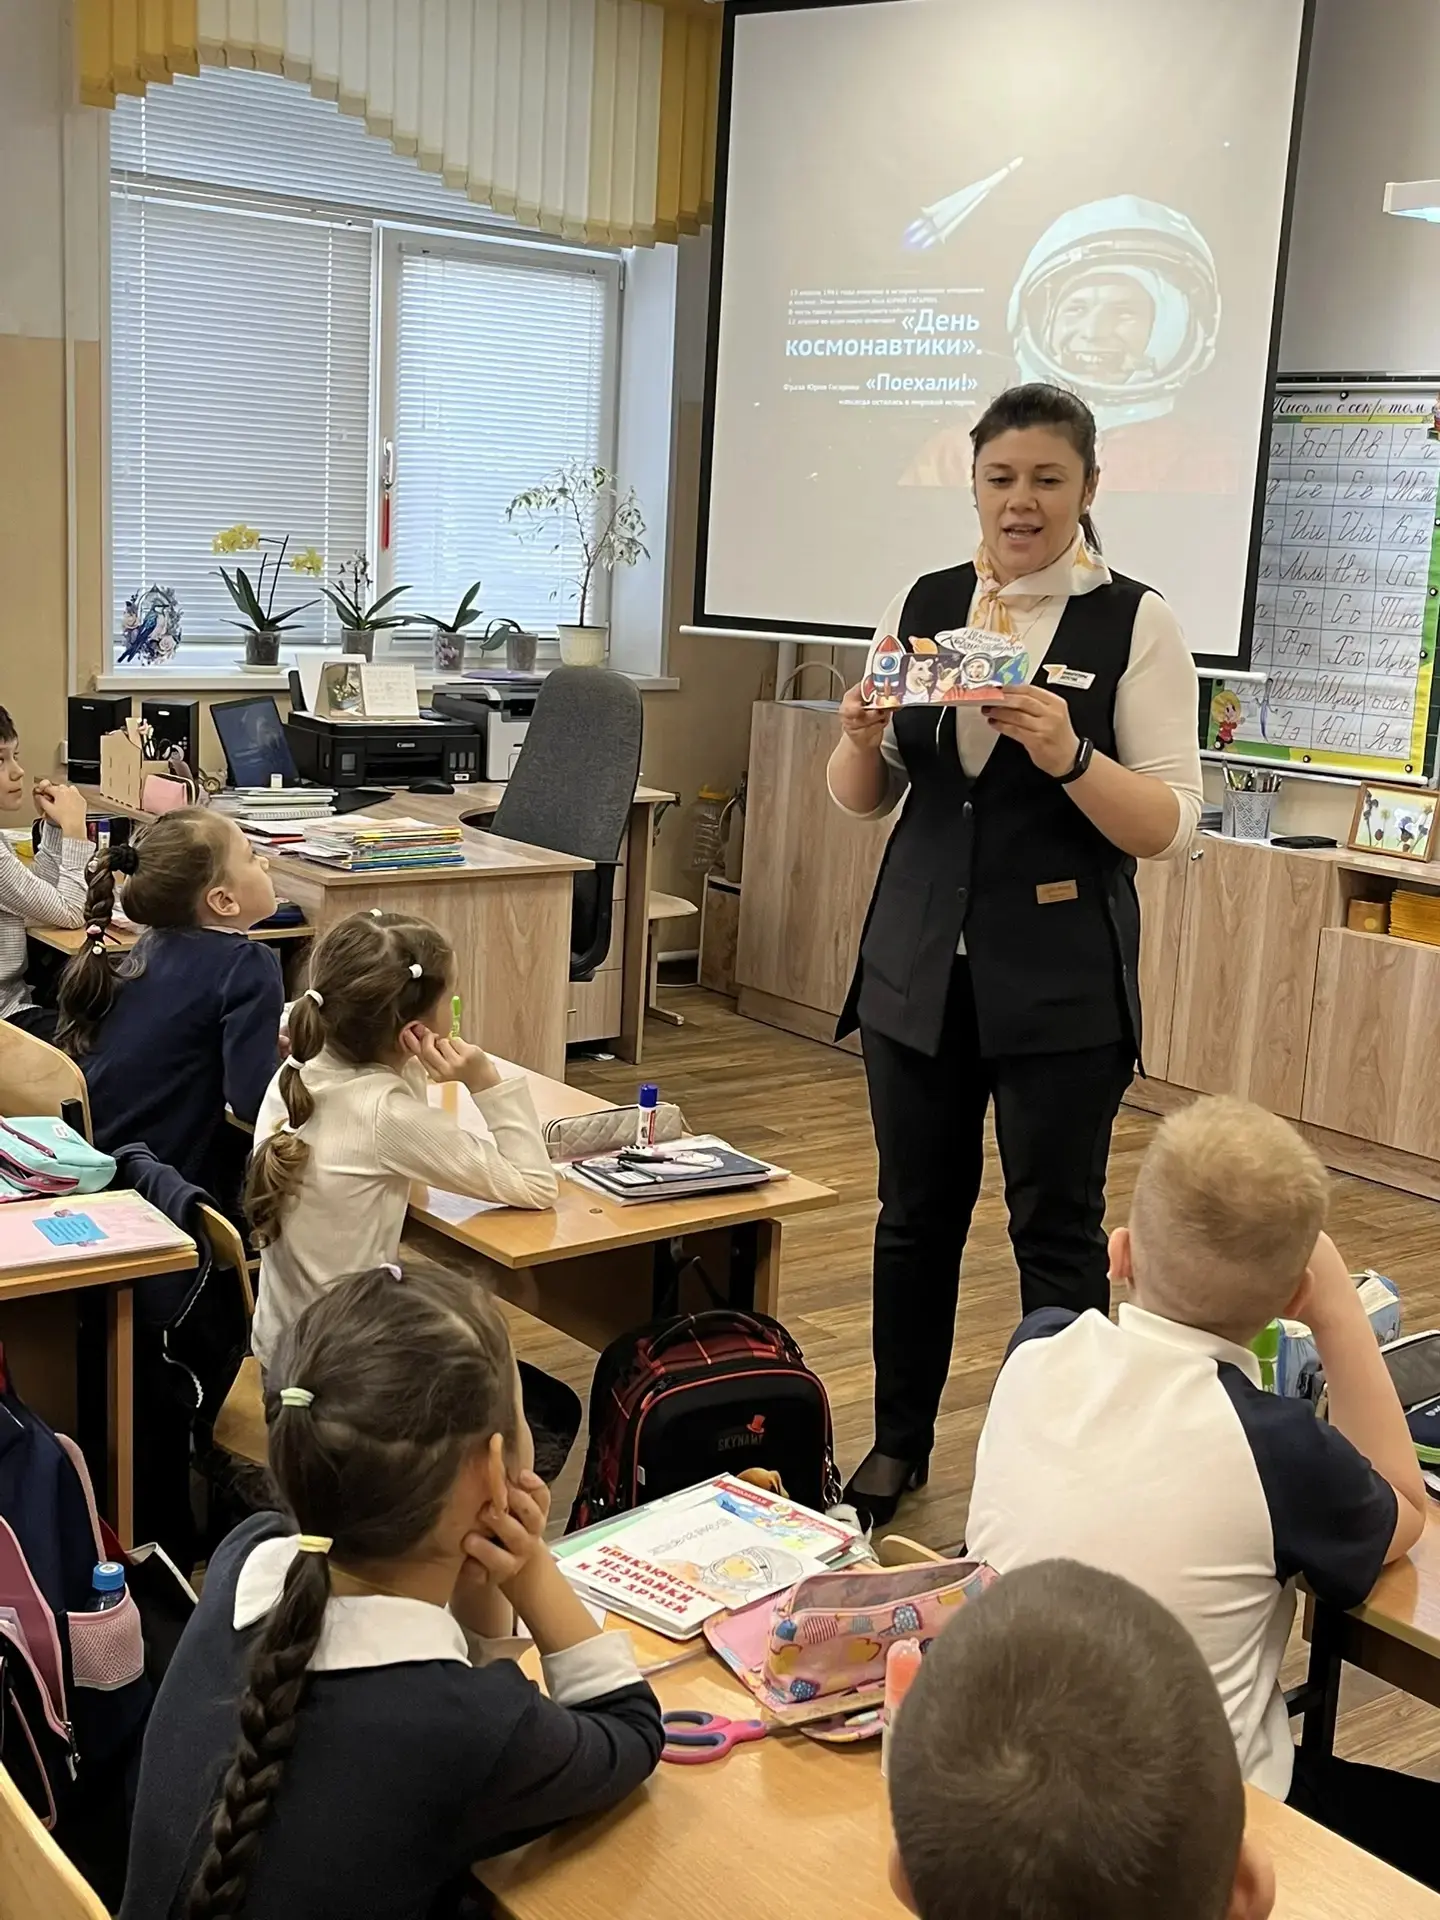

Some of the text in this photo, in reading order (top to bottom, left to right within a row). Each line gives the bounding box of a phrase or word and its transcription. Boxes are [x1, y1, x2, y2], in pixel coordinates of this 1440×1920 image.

[901, 308, 980, 335] «День
[785, 338, 983, 356] космонавтики».
[866, 372, 978, 391] «Поехали!»
[576, 1562, 689, 1614] И ЕГО ДРУЗЕЙ
[597, 1545, 716, 1602] ПРИКЛЮЧЕН
[597, 1558, 694, 1603] НЕЗНАЙКИ
